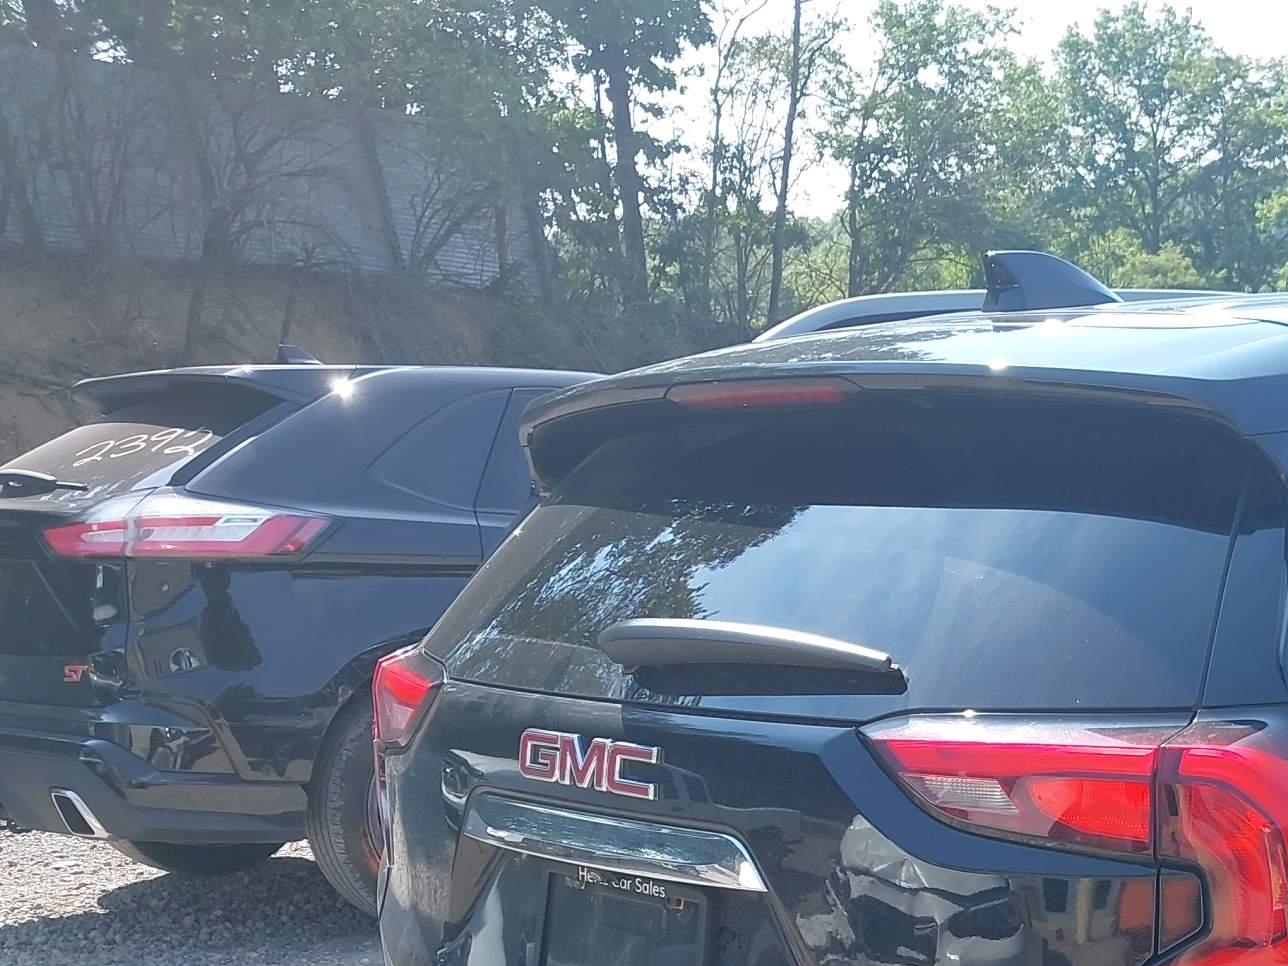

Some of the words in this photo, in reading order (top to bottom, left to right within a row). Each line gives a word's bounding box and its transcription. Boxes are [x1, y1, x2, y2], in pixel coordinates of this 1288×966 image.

[72, 426, 213, 467] 2392
[63, 665, 89, 682] ST
[518, 727, 661, 801] GMC
[635, 877, 666, 898] Sales
